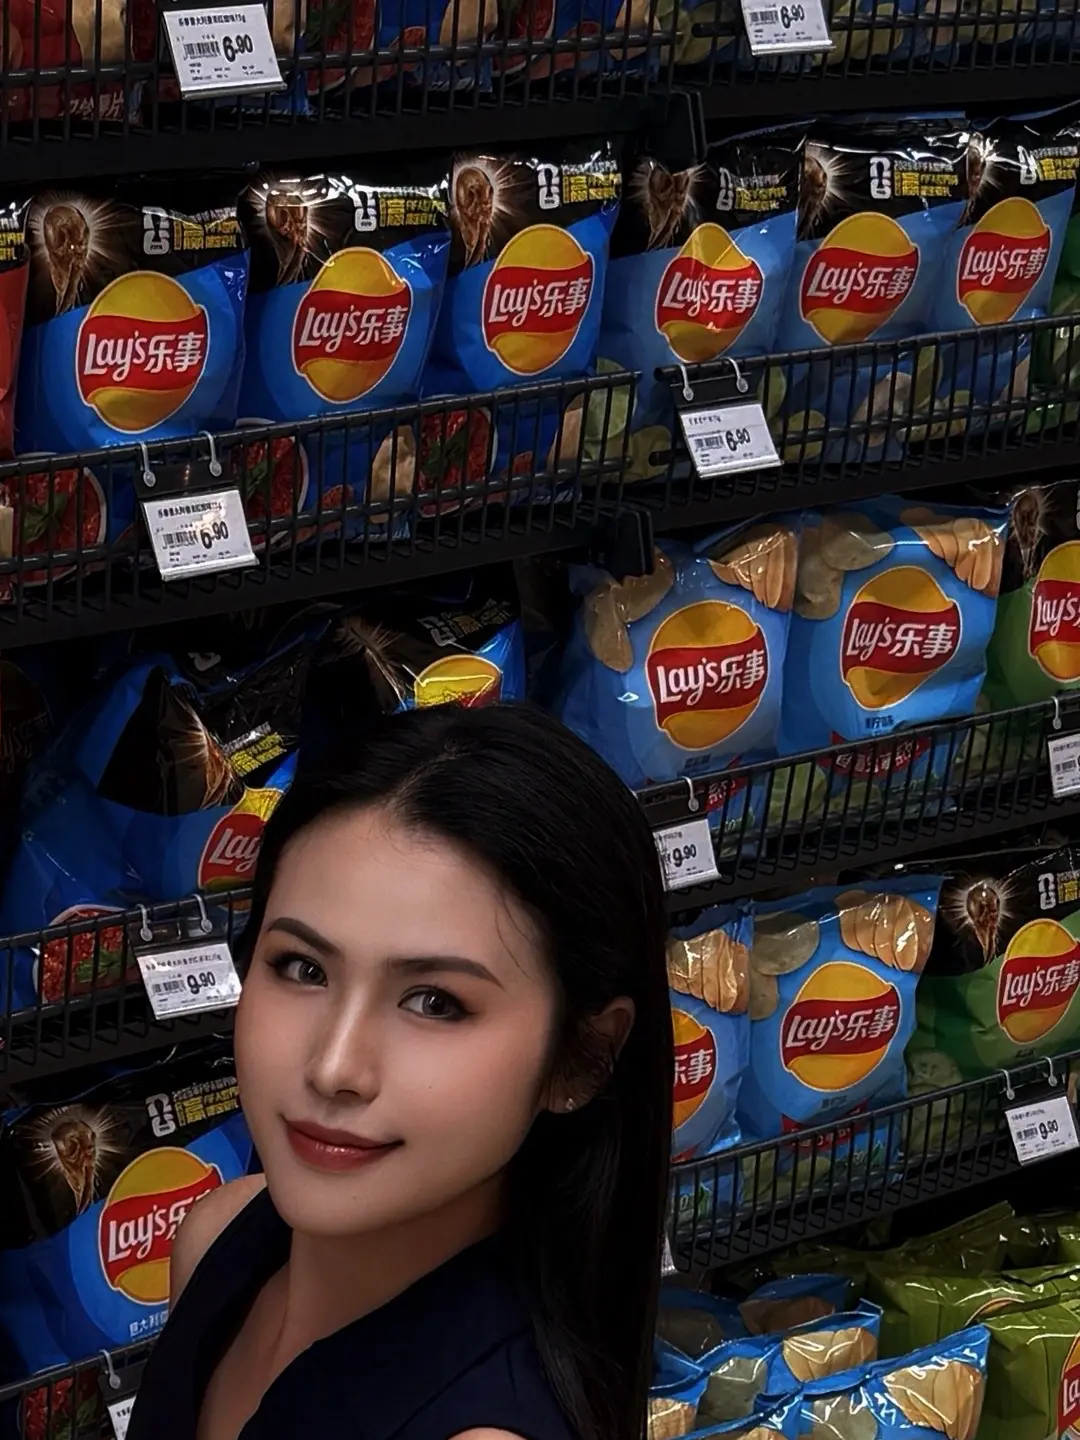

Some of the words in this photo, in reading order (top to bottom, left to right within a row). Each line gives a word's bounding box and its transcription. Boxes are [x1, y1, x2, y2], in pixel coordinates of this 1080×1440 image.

[780, 4, 805, 28] 6.90
[222, 34, 253, 63] 6.90
[725, 428, 751, 451] 6.90
[199, 521, 229, 550] 6.90
[672, 843, 697, 867] 9.90
[186, 971, 216, 995] 9.90
